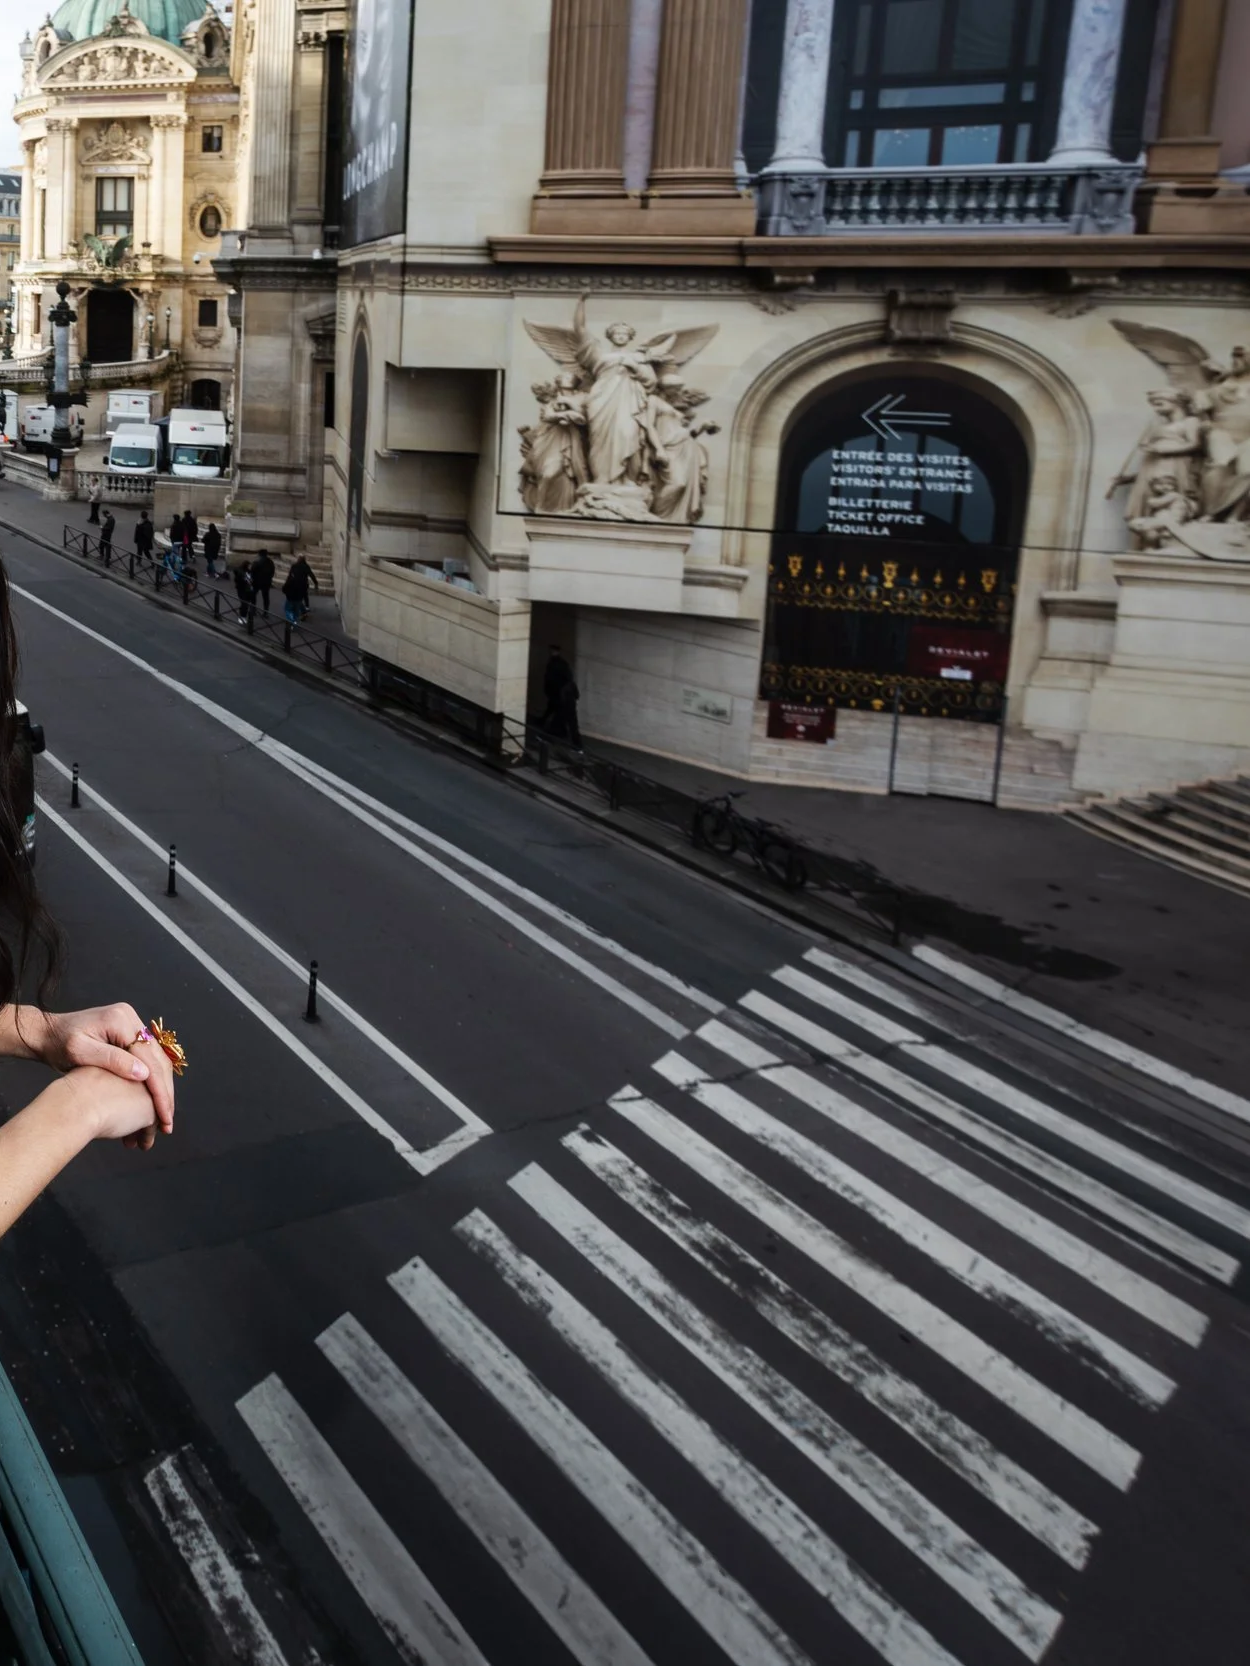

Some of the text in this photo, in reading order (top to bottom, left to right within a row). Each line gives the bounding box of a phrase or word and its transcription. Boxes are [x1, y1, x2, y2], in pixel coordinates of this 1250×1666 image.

[831, 449, 971, 466] ENTRÉE DES VISITES
[898, 466, 973, 480] ENTRANCE
[829, 477, 973, 494] ENTRADA PARA VISITAS
[828, 496, 913, 510] BILLETTERIE
[827, 510, 925, 525] TICKET OFFICE
[826, 523, 891, 536] TAQUILLA
[928, 645, 990, 659] DEVIALET
